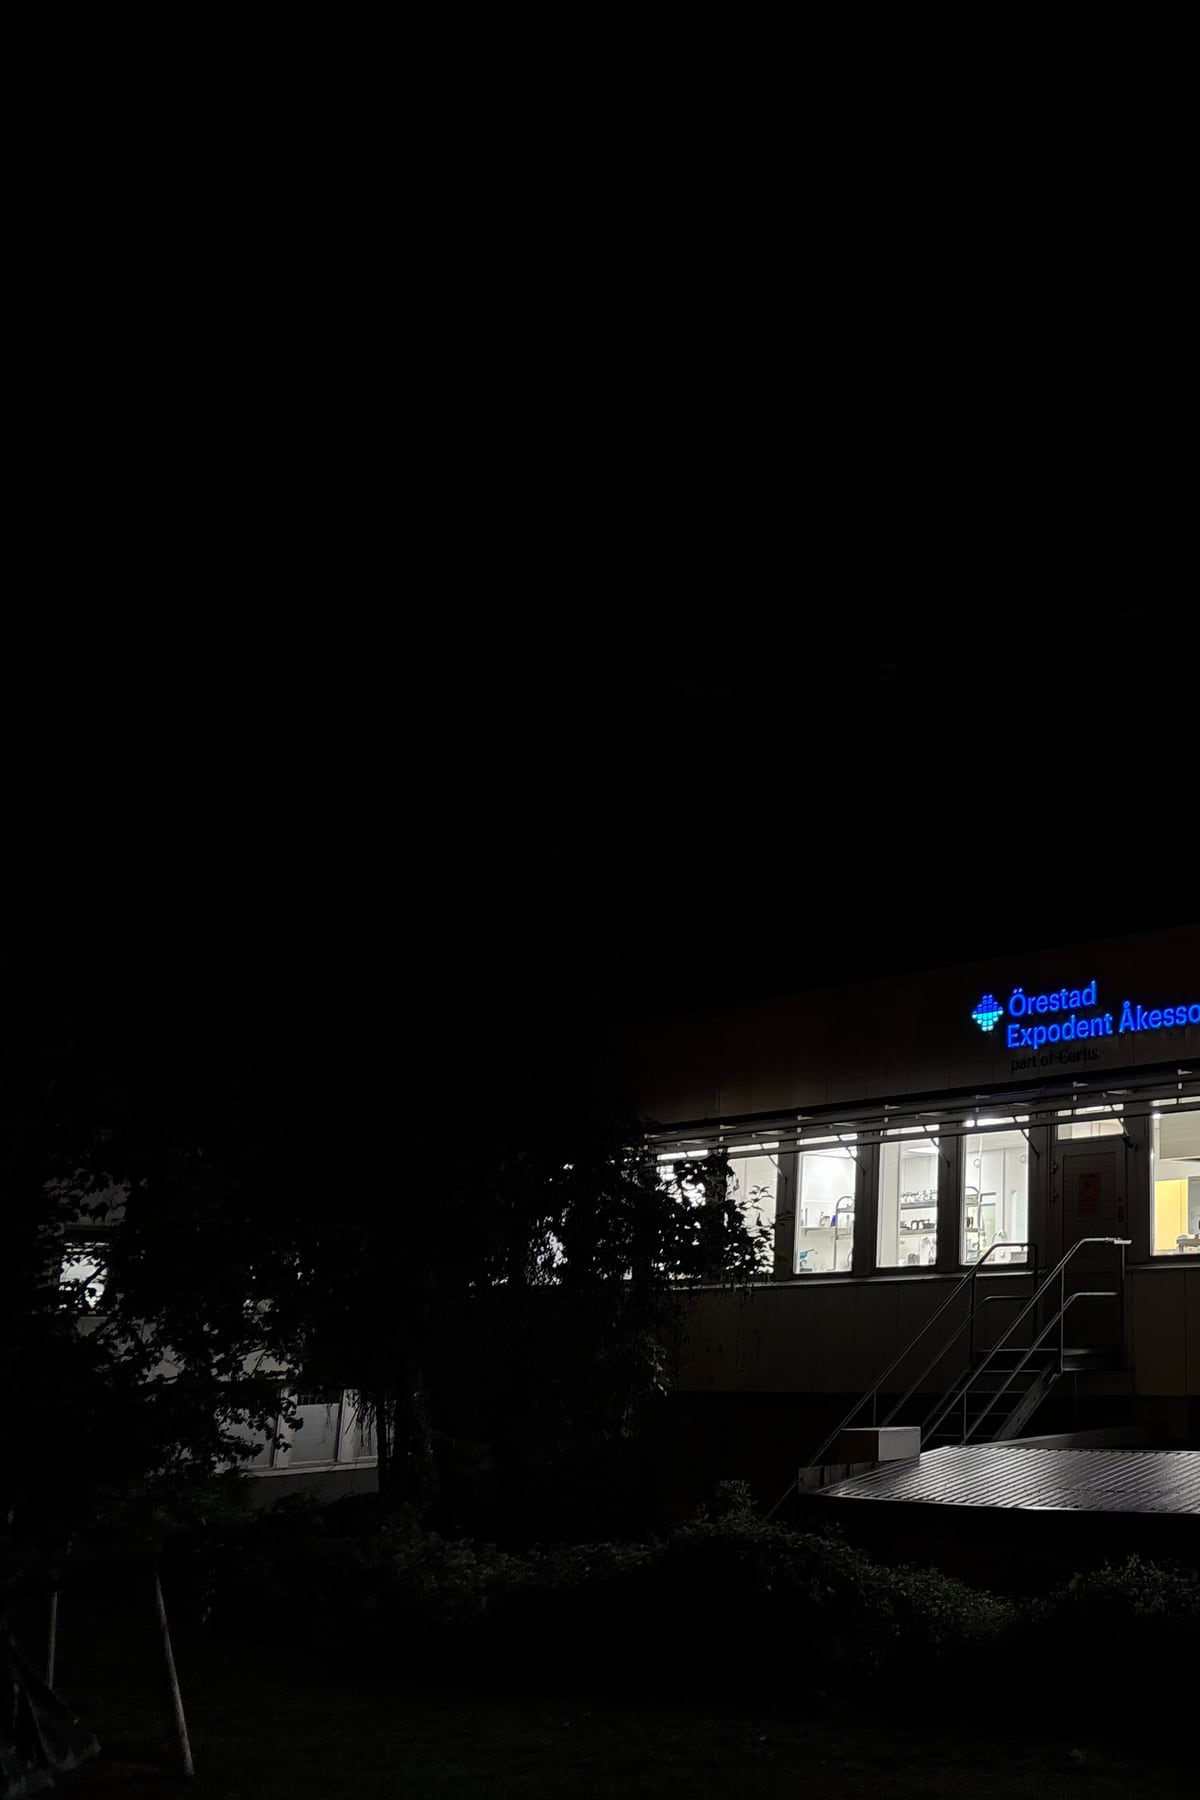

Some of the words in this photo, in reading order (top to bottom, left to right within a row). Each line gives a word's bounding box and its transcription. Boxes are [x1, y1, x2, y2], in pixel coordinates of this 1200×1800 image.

[1008, 980, 1098, 1017] Örestad
[1006, 1013, 1113, 1050] Expodent
[1011, 1055, 1037, 1074] part
